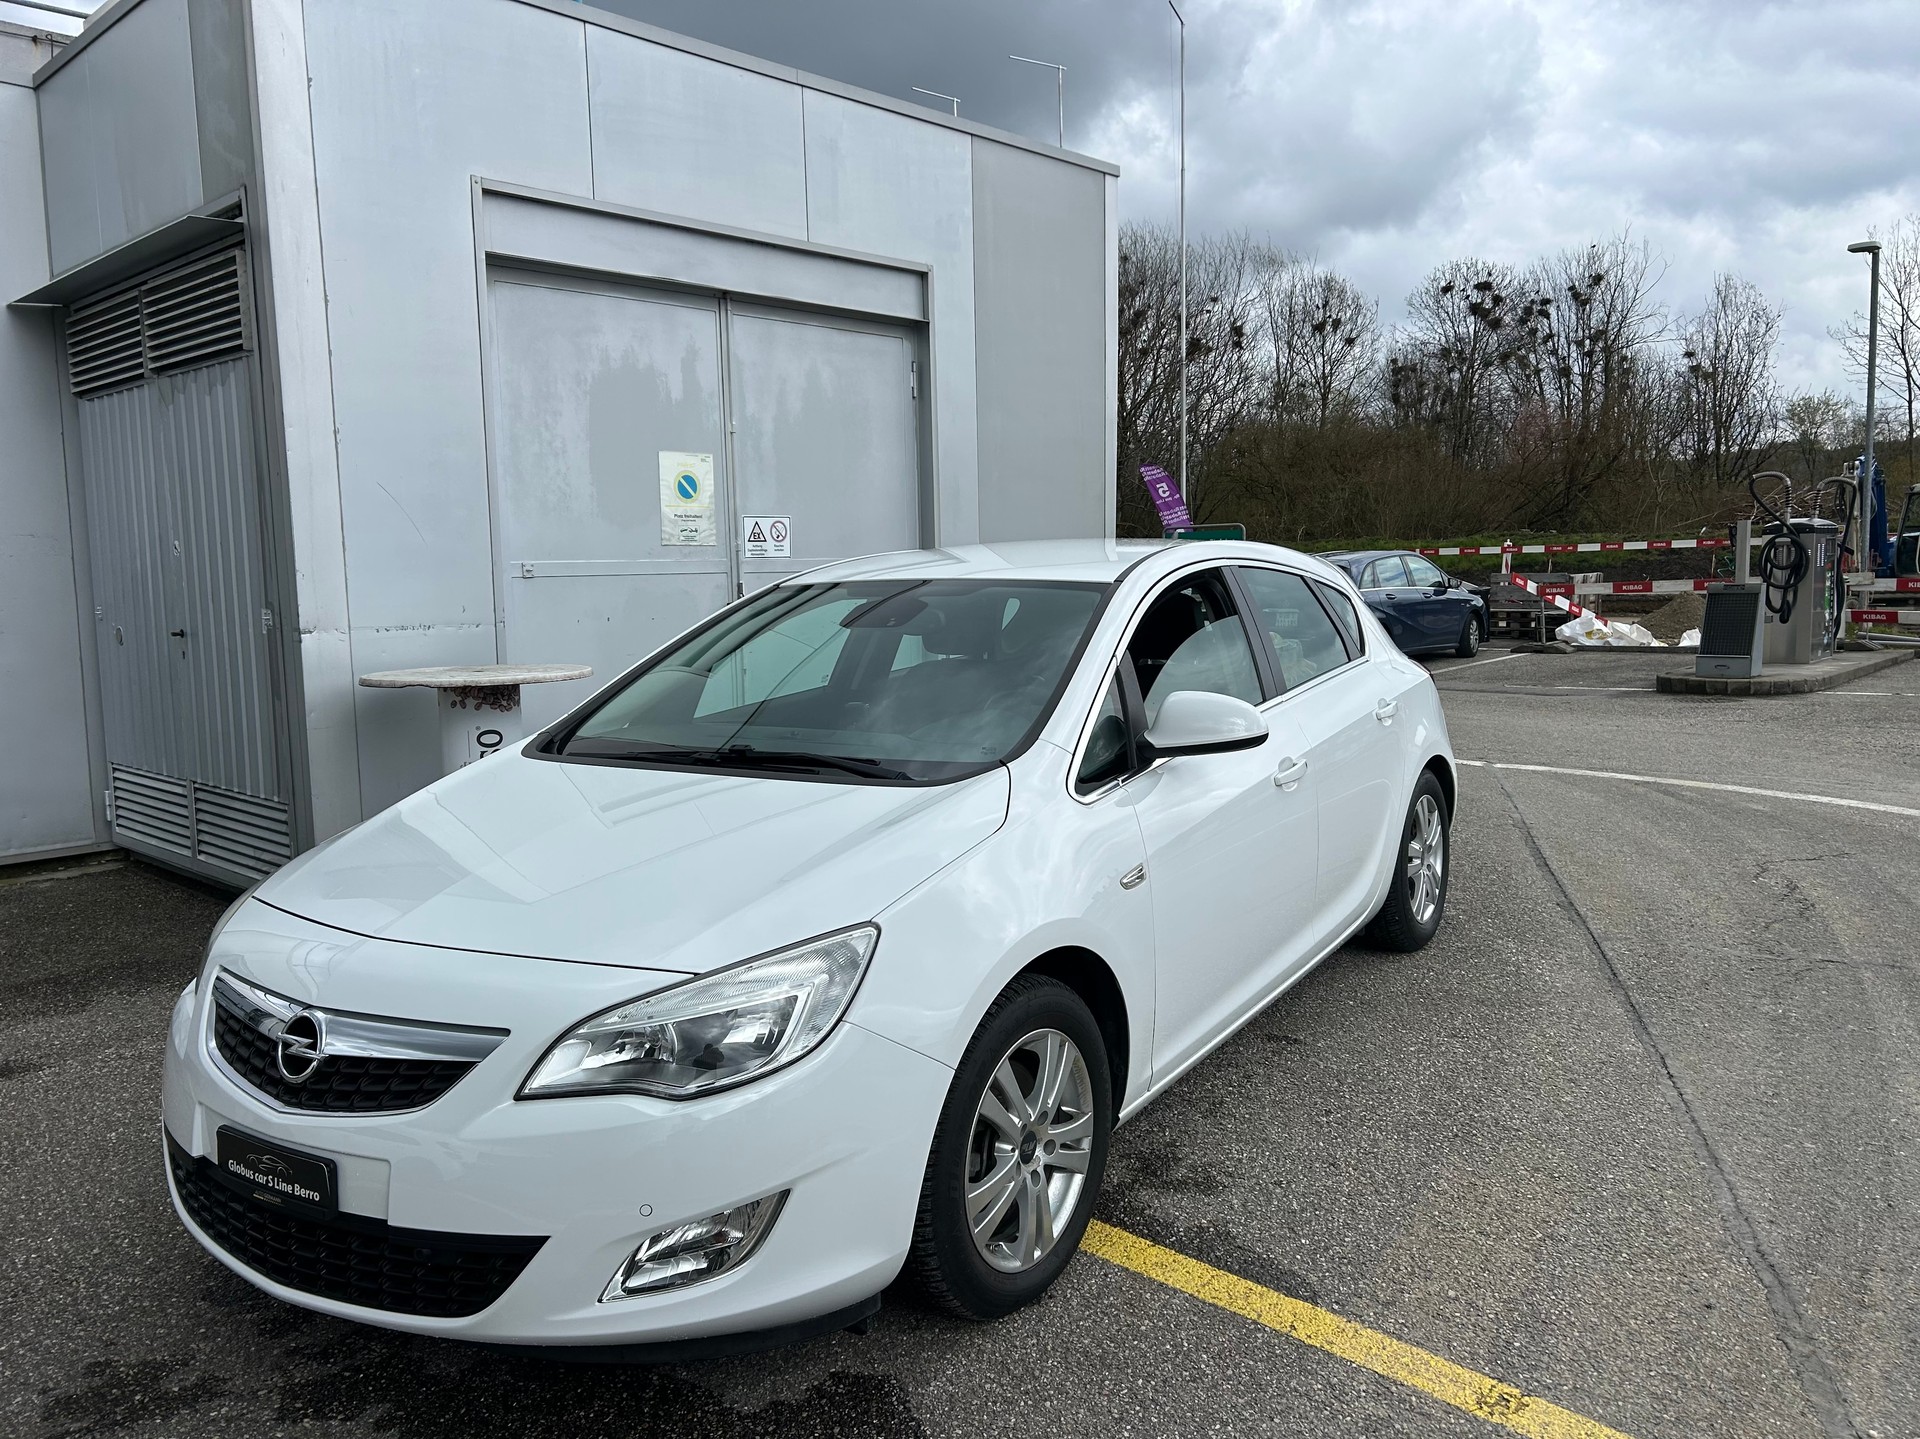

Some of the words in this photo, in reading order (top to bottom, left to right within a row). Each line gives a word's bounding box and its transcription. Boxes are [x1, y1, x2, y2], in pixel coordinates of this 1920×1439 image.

[752, 532, 762, 540] EX
[228, 1159, 254, 1180] Globus
[254, 1172, 267, 1185] car
[267, 1175, 274, 1188] S
[274, 1177, 293, 1194] Line
[294, 1183, 320, 1202] Berro
